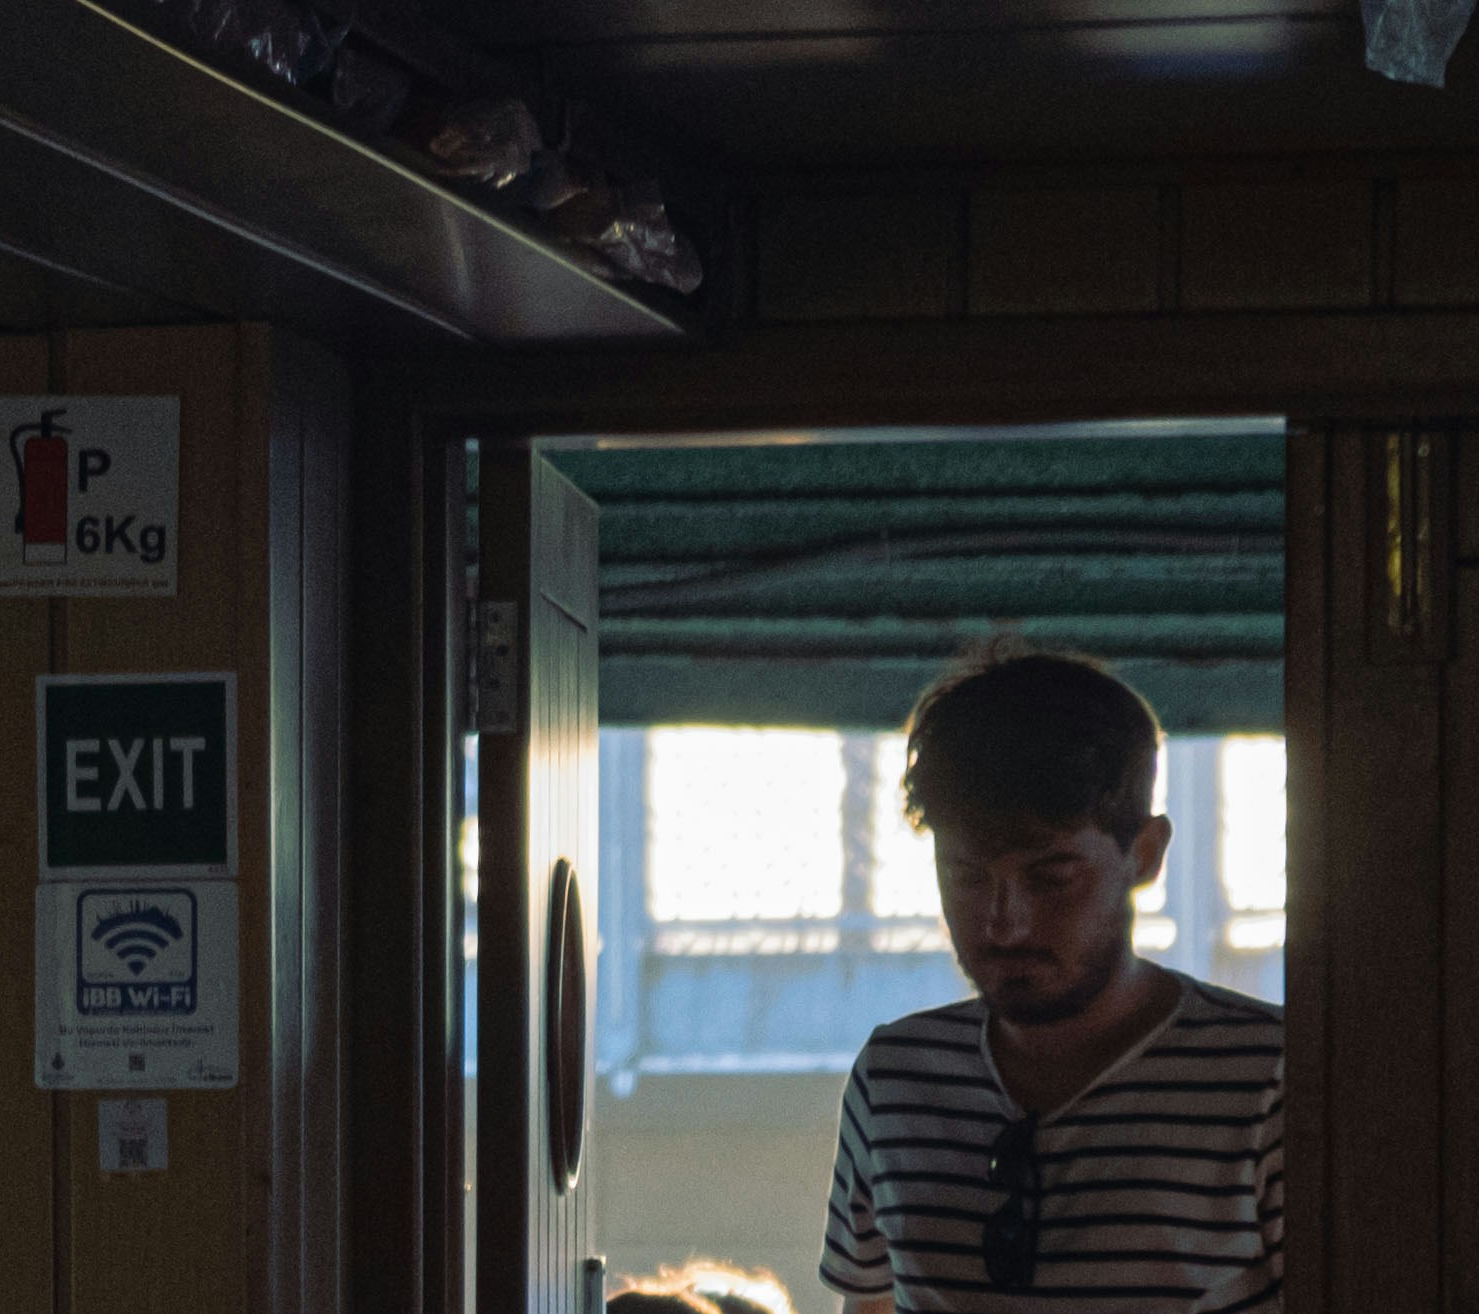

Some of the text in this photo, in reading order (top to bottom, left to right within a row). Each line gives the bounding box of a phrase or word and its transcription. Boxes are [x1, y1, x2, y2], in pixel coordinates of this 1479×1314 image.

[76, 447, 112, 493] P
[74, 515, 168, 563] 6Kg
[65, 735, 207, 814] EXIT
[126, 985, 192, 1009] Wi-Fi
